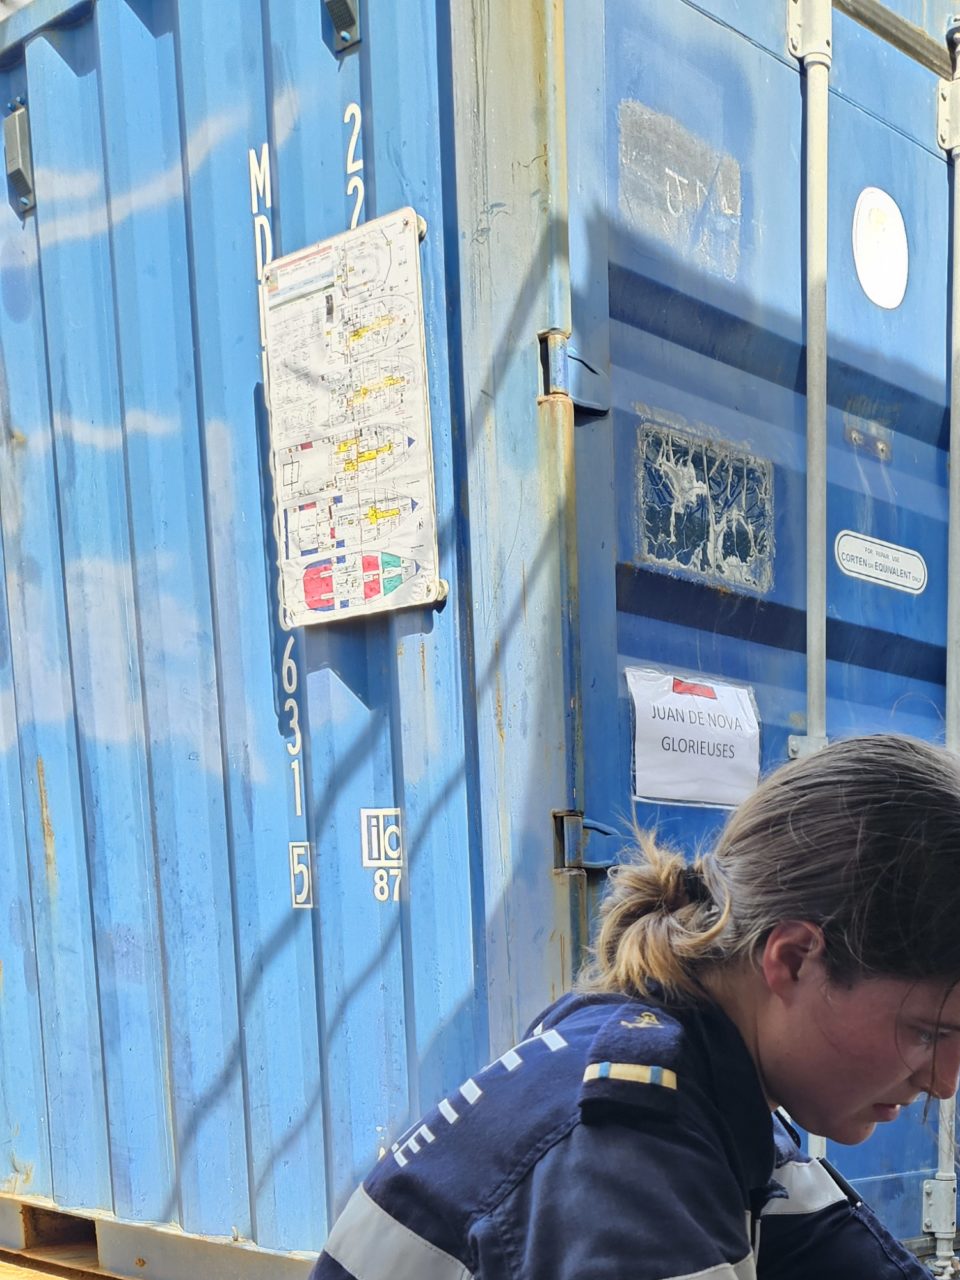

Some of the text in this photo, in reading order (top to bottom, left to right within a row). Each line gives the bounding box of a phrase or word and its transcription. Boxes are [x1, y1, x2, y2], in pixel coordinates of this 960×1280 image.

[841, 551, 868, 567] CORTEN
[874, 561, 912, 580] EQUIVALENT
[279, 605, 303, 816] 631
[652, 704, 743, 731] JUAN DE NOVA
[661, 736, 735, 759] GLORIEUSES
[291, 846, 310, 904] 5
[373, 868, 402, 902] 87
